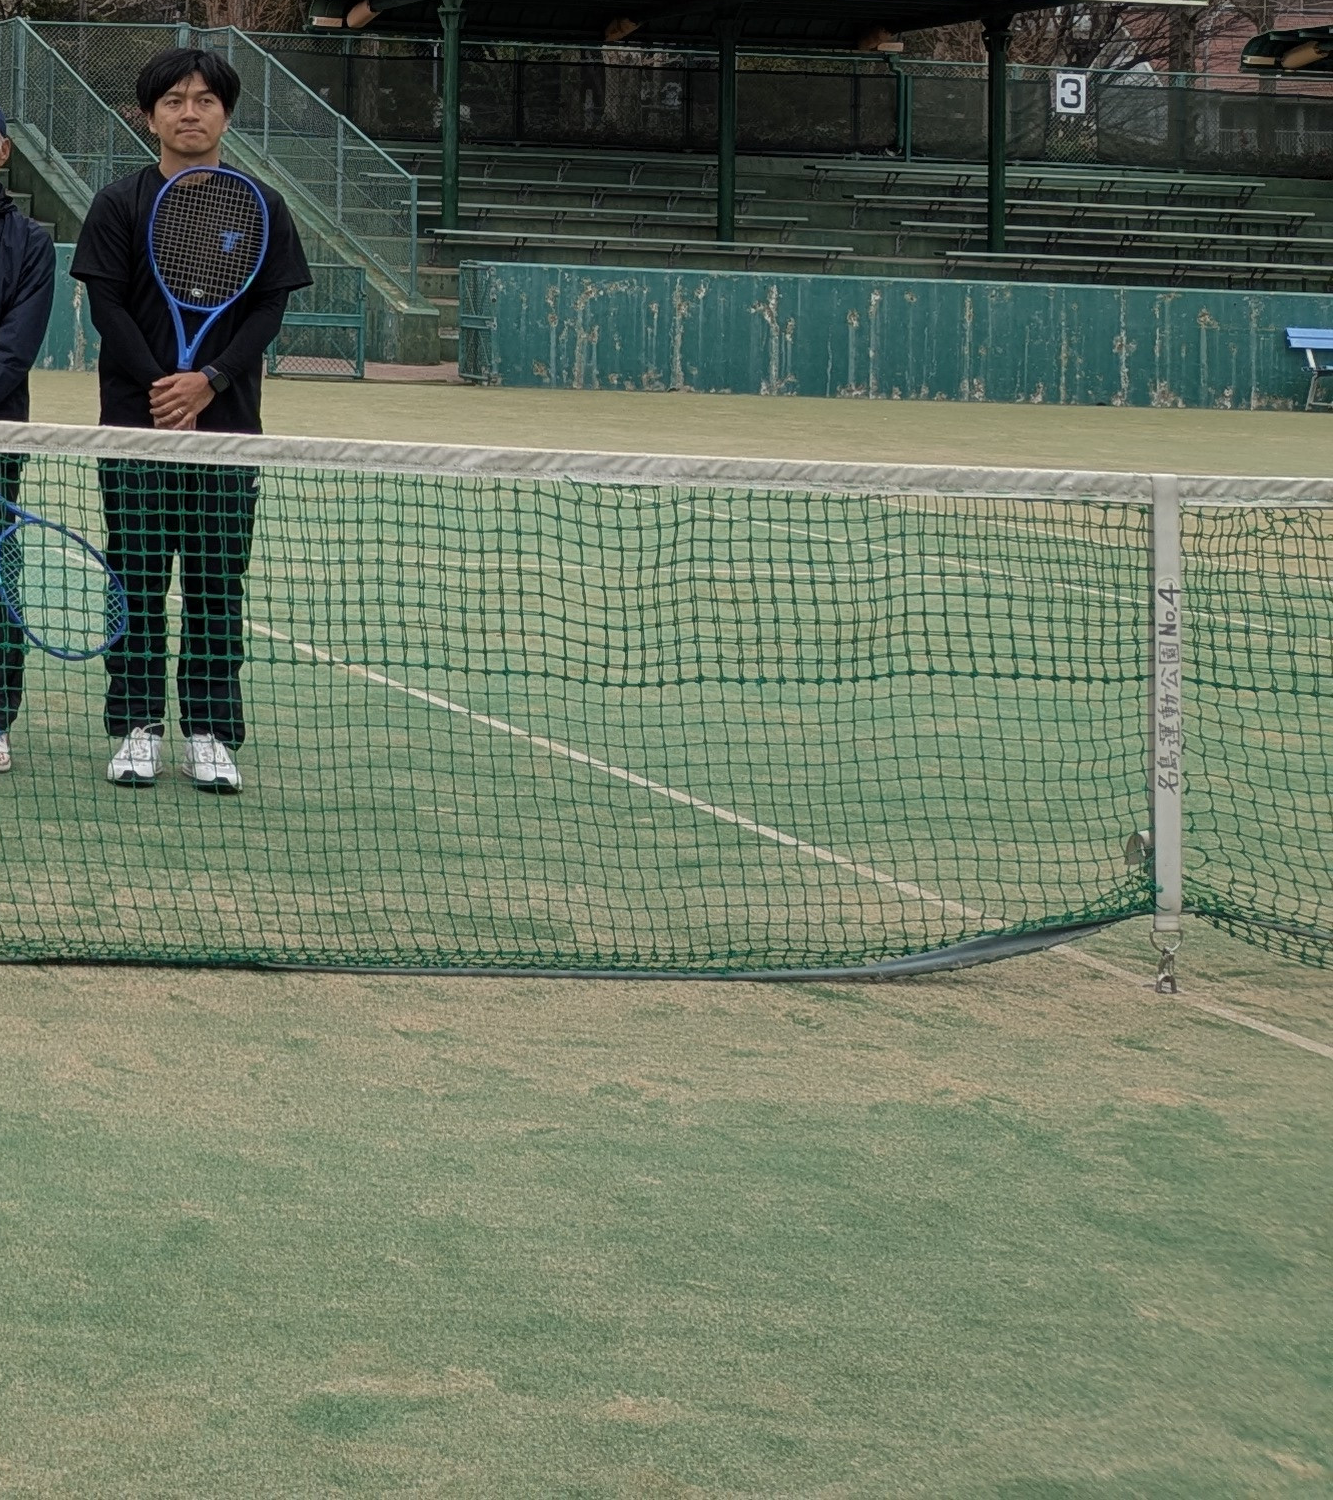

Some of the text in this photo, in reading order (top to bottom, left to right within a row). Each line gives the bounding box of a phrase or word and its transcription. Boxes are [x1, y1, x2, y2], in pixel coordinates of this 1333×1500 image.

[1060, 78, 1081, 108] 3
[1156, 581, 1181, 796] 名島運動公園 No.4
